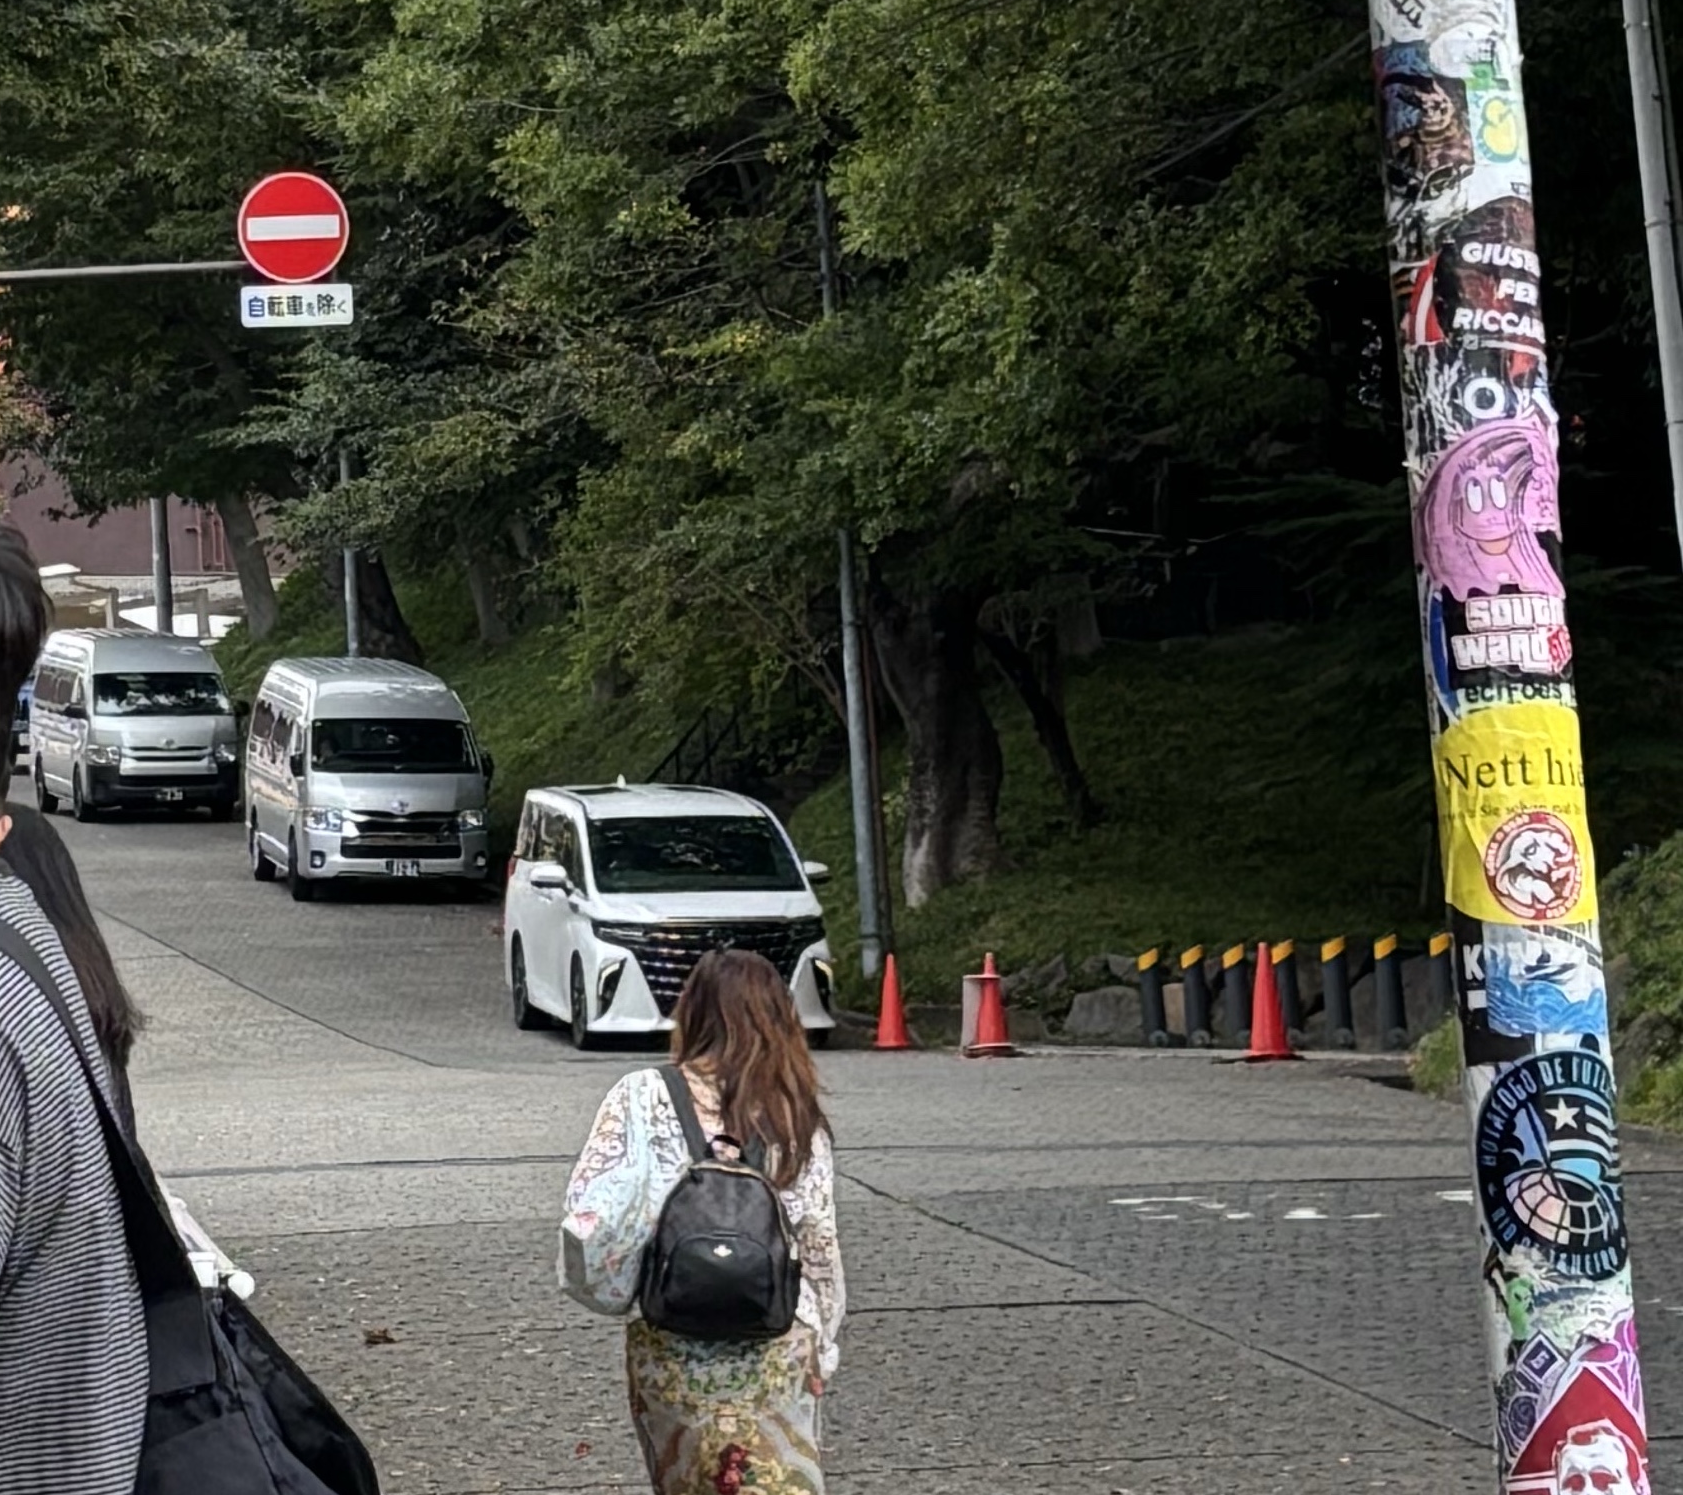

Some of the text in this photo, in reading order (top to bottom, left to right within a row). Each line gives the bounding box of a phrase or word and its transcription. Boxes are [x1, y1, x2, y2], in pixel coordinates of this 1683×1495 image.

[247, 292, 348, 319] 自転車を除く
[1443, 750, 1537, 791] Nett
